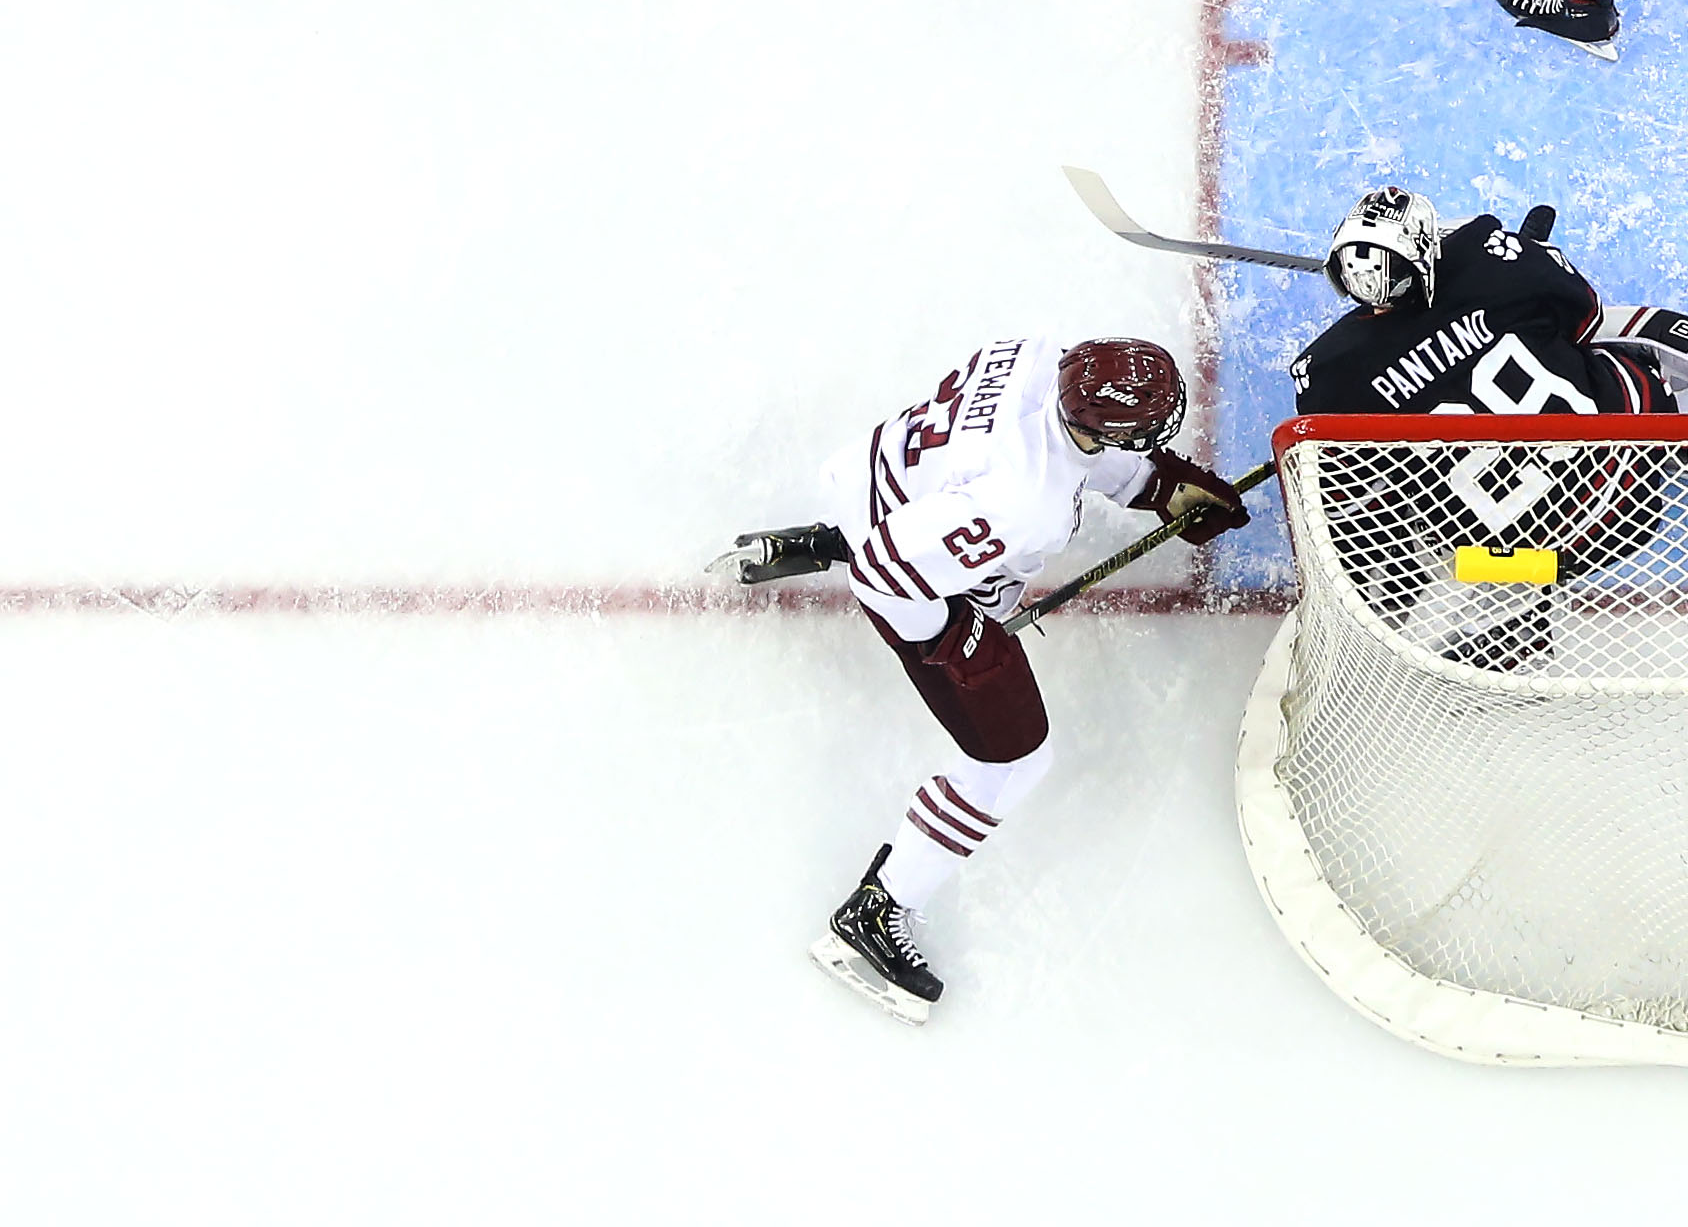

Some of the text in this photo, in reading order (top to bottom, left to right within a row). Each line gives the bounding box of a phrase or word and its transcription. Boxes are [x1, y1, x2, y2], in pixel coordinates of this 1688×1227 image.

[961, 338, 1028, 434] TEWART
[1371, 309, 1495, 409] PANTANO
[942, 517, 1006, 569] 23
